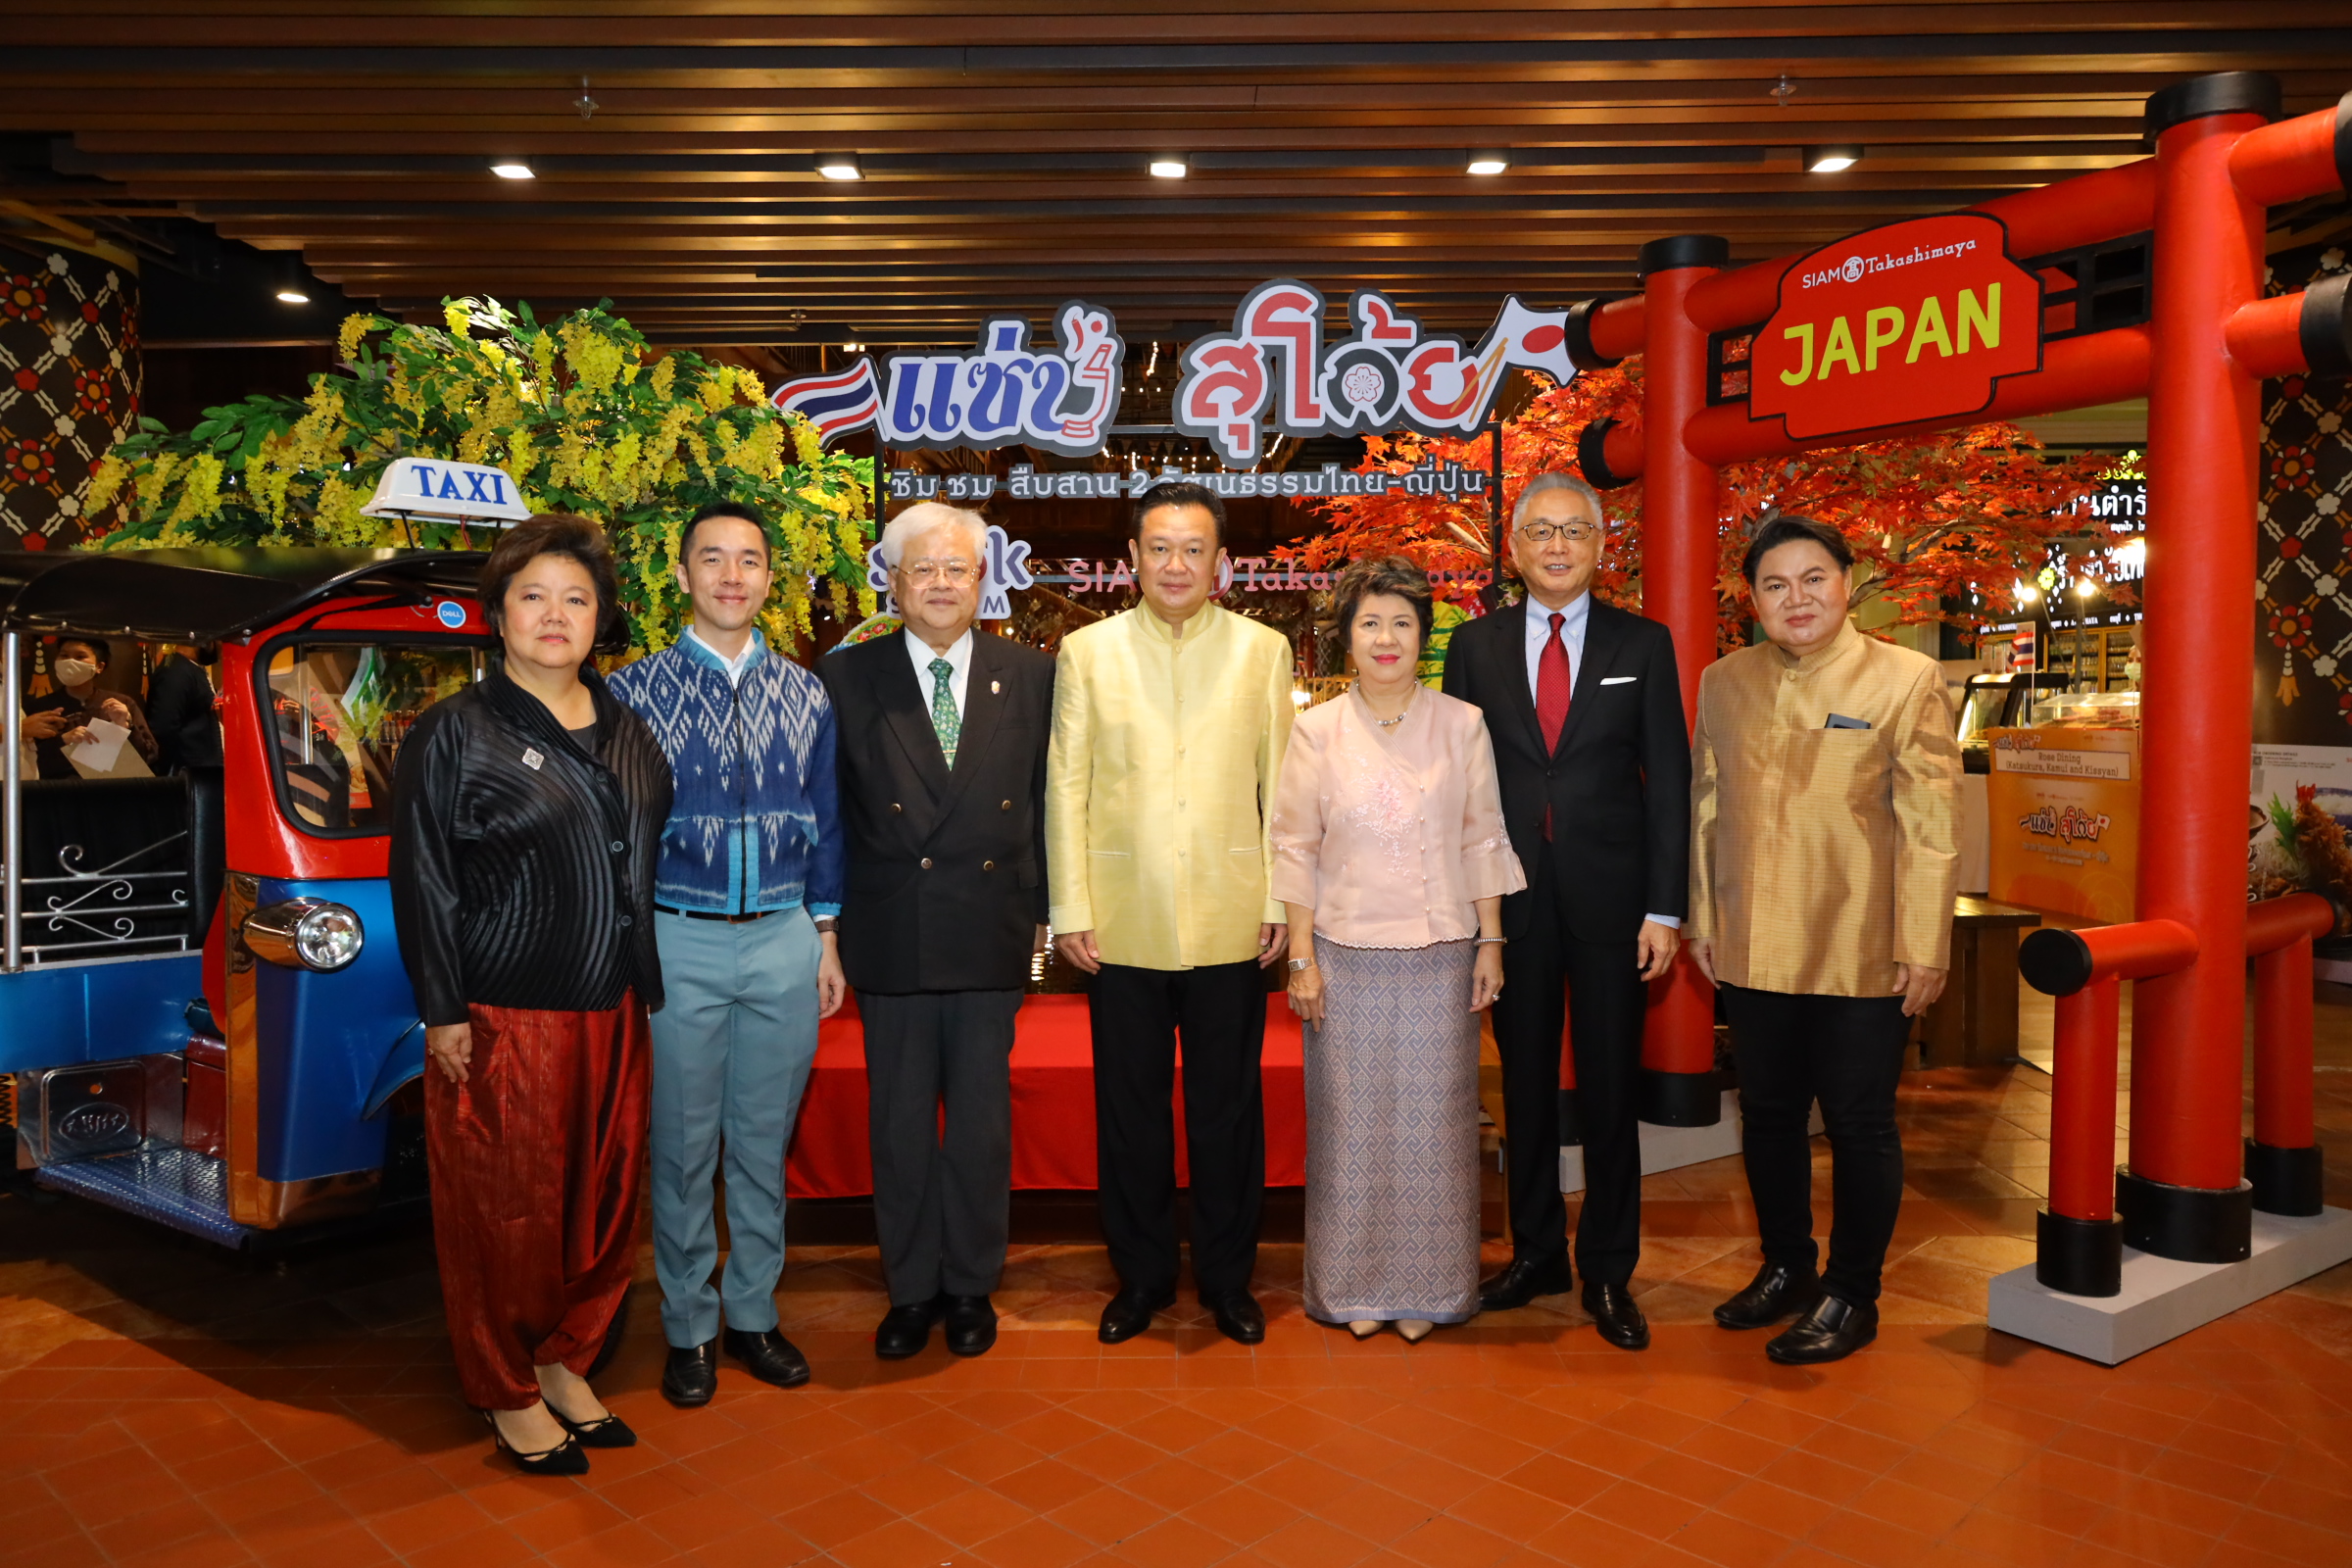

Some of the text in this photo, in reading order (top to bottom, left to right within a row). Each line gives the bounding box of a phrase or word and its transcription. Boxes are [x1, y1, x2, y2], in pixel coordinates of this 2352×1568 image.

[1802, 267, 1840, 289] SIAM
[1865, 239, 1977, 273] Takashimaya
[1779, 281, 2001, 386] JAPAN
[1190, 291, 1480, 452] สุโก้ย
[410, 465, 508, 505] TAXI
[891, 471, 937, 497] ชิม
[947, 476, 994, 497] ชม
[1010, 466, 1117, 497] สืบสาน
[1131, 471, 1149, 495] 2
[1068, 560, 1137, 593] SIA
[1237, 557, 1494, 599] Takaaya
[442, 610, 462, 618] DELL
[2038, 752, 2082, 764] Rose Dining
[2046, 763, 2068, 773] Kamui
[2070, 764, 2082, 774] and
[2084, 765, 2119, 778] Kissyan)
